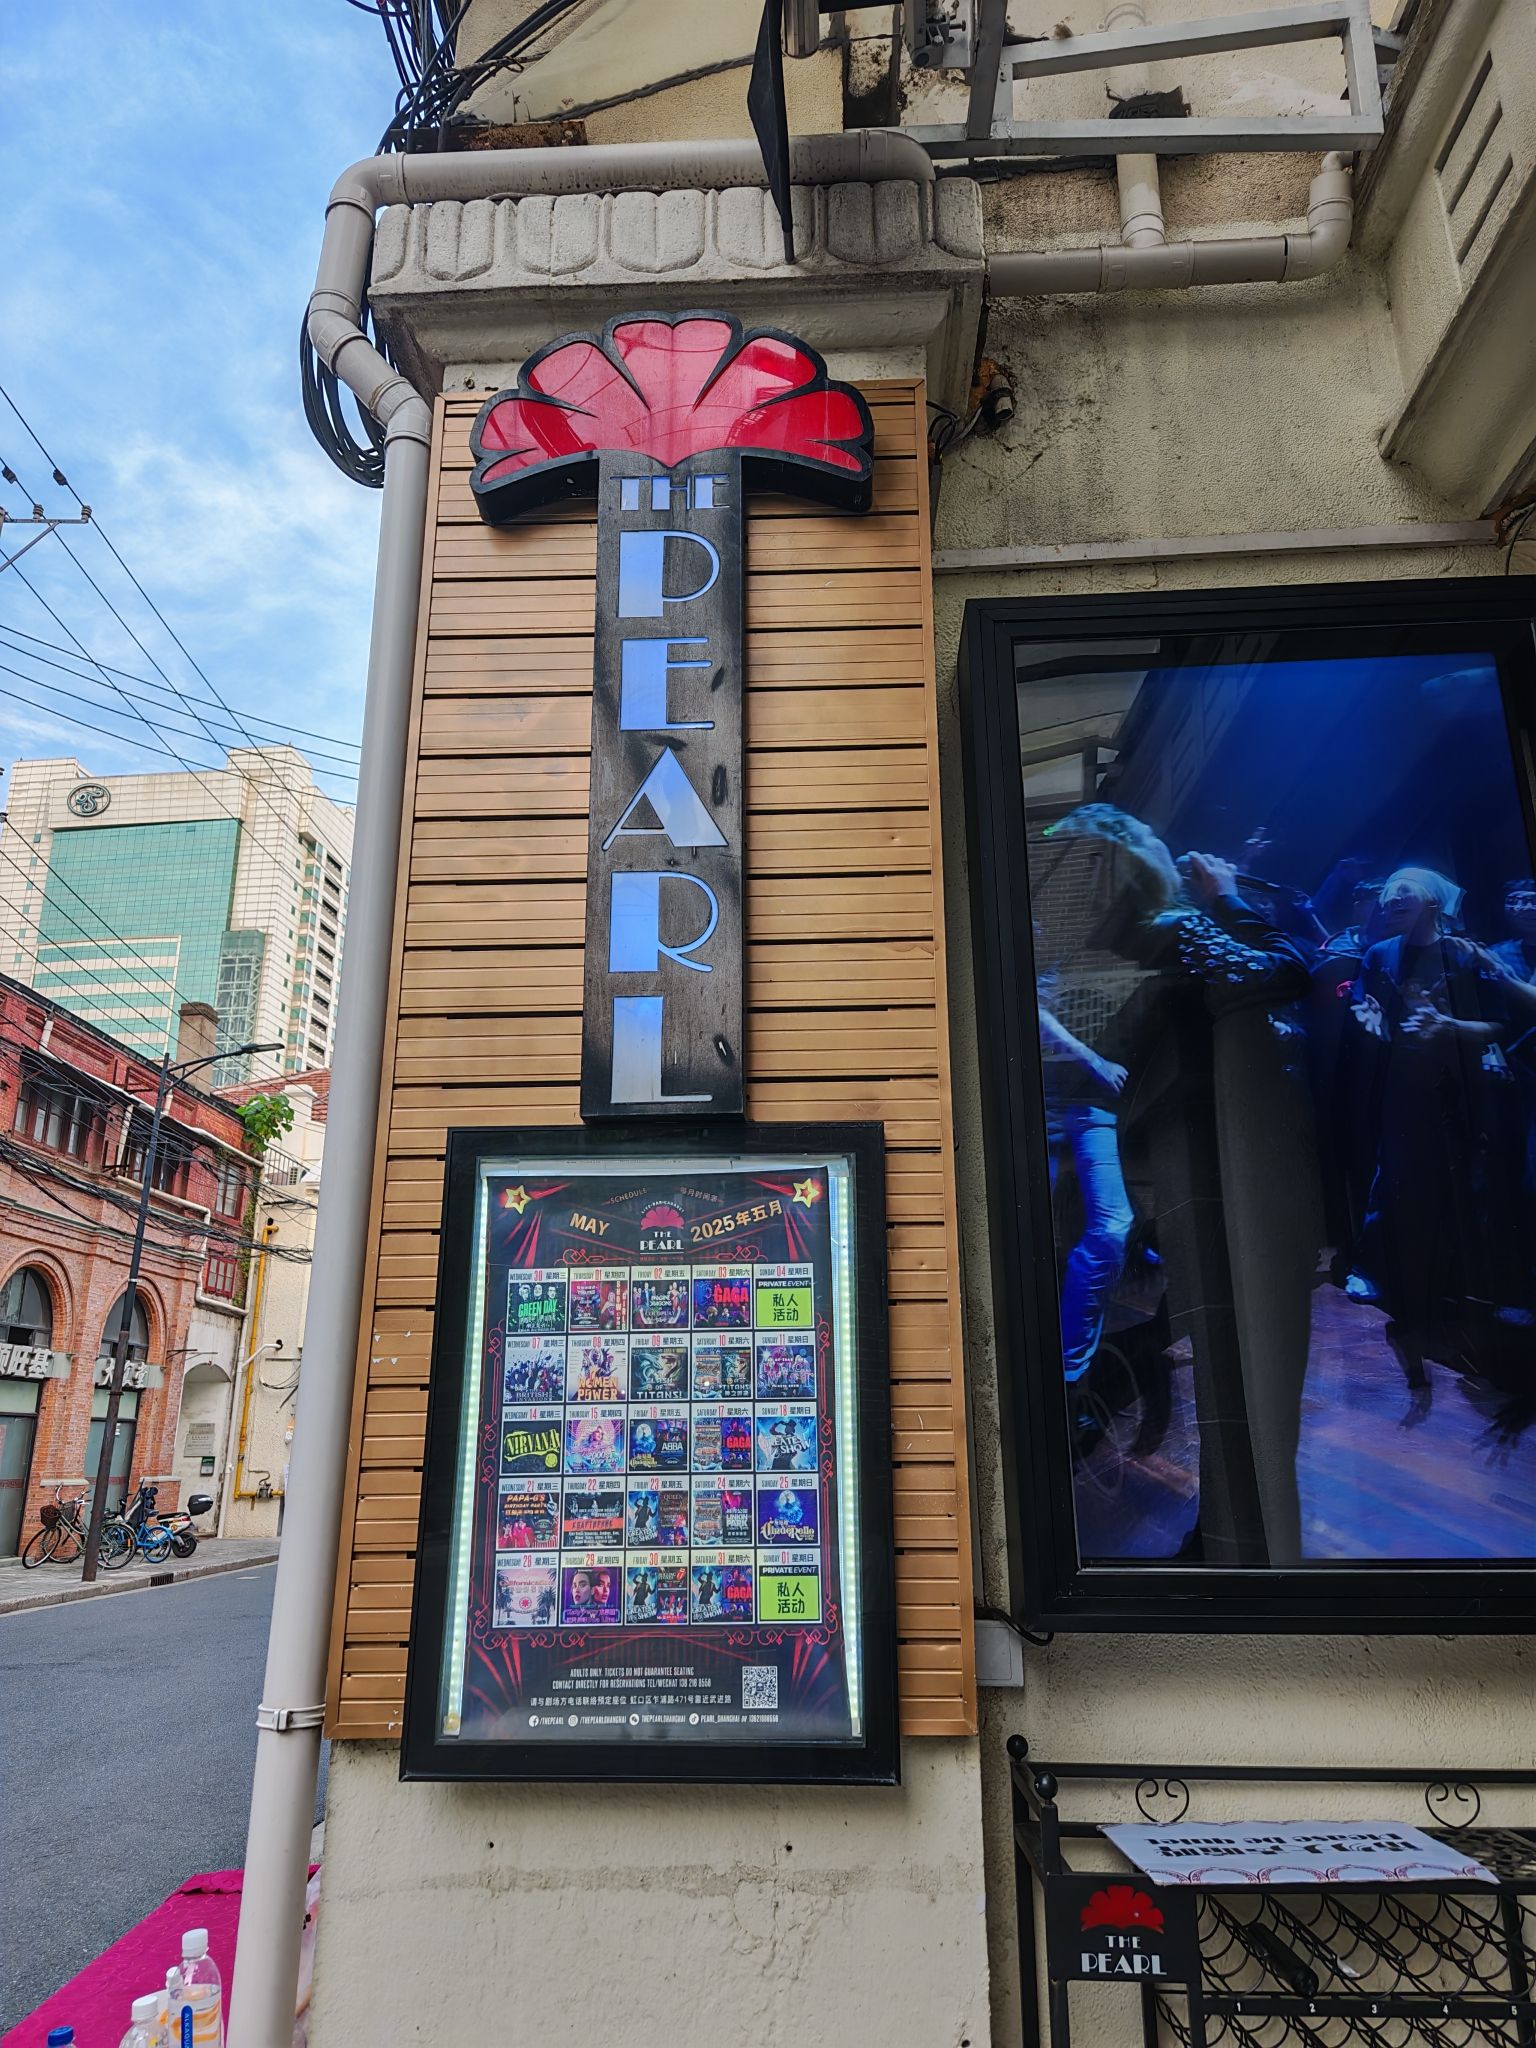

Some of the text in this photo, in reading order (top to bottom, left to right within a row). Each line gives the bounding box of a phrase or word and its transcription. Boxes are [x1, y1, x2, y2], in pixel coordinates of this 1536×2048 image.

[610, 473, 730, 511] THE
[602, 529, 729, 1104] PEARL
[610, 1187, 648, 1205] SCHEDULE
[569, 1213, 610, 1236] MAY
[690, 1199, 783, 1242] 2025年五月
[640, 1239, 685, 1250] PEARL
[533, 1270, 543, 1281] 30
[546, 1272, 566, 1280] 星期三
[595, 1269, 602, 1281] 01
[604, 1271, 626, 1279] 星期四
[654, 1267, 663, 1279] 02
[664, 1269, 686, 1278] 星期五
[719, 1267, 727, 1277] 03
[729, 1268, 750, 1277] 星期六
[777, 1265, 785, 1276] 04
[787, 1268, 808, 1276] 星期日
[714, 1286, 749, 1305] GAGA
[772, 1293, 799, 1307] 私人
[518, 1297, 558, 1318] GREEN DAY
[773, 1307, 799, 1322] 活动
[532, 1337, 540, 1349] 07
[544, 1339, 564, 1347] 星期三
[593, 1336, 602, 1348] 08
[604, 1338, 626, 1346] 星期四
[652, 1335, 661, 1346] 09
[663, 1337, 684, 1345] 星期五
[719, 1334, 726, 1346] 10
[728, 1336, 750, 1345] 星期六
[780, 1334, 785, 1346] 11
[787, 1335, 809, 1344] 星期日
[579, 1376, 618, 1389] WOMEN
[577, 1388, 618, 1401] POWER
[637, 1391, 682, 1399] TITANS!
[529, 1408, 537, 1420] 14
[540, 1410, 561, 1418] 星期三
[591, 1407, 598, 1419] 15
[600, 1409, 622, 1418] 星期四
[650, 1406, 658, 1418] 16
[660, 1408, 681, 1417] 星期五
[718, 1405, 725, 1417] 17
[727, 1408, 749, 1416] 星期六
[780, 1404, 788, 1416] 18
[789, 1406, 811, 1415] 星期日
[505, 1429, 560, 1456] NIRVANA
[661, 1442, 684, 1451] ABBA
[726, 1436, 751, 1449] GAGA
[527, 1480, 534, 1492] 21
[537, 1482, 559, 1490] 星期三
[588, 1478, 597, 1491] 22
[598, 1481, 621, 1489] 星期四
[651, 1478, 659, 1490] 23
[661, 1480, 683, 1489] 星期五
[718, 1477, 725, 1489] 24
[728, 1479, 751, 1488] 星期六
[780, 1476, 788, 1489] 25
[791, 1478, 812, 1487] 星期日
[726, 1520, 748, 1528] PARK
[523, 1554, 532, 1567] 28
[535, 1557, 557, 1566] 星期三
[586, 1553, 595, 1567] 29
[597, 1556, 620, 1565] 星期四
[649, 1552, 658, 1566] 30
[661, 1555, 683, 1564] 星期五
[718, 1552, 725, 1564] 31
[728, 1554, 751, 1563] 星期六
[781, 1551, 790, 1564] 01
[792, 1553, 814, 1563] 星期日
[762, 1566, 817, 1574] PRIVATE EVENT
[727, 1586, 752, 1599] GAGA
[777, 1581, 805, 1598] 私人
[777, 1598, 805, 1614] 活动
[569, 1668, 588, 1678] ADULTS
[604, 1667, 624, 1677] TICKETS
[625, 1667, 633, 1676] DO
[633, 1667, 643, 1676] NOT
[644, 1667, 673, 1676] GUARANTEE
[673, 1666, 694, 1676] SEATING
[552, 1680, 574, 1690] CONTACT
[575, 1680, 598, 1689] DIRECTLY
[599, 1679, 609, 1689] FOR
[610, 1679, 646, 1689] RESERVATIONS
[647, 1678, 678, 1688] TEL/WECHAT
[1292, 1833, 1403, 1843] Please
[1105, 1935, 1141, 1949] THE
[1081, 1952, 1167, 1976] PEARL
[1236, 2002, 1517, 2015] 1 2 3 4 5
